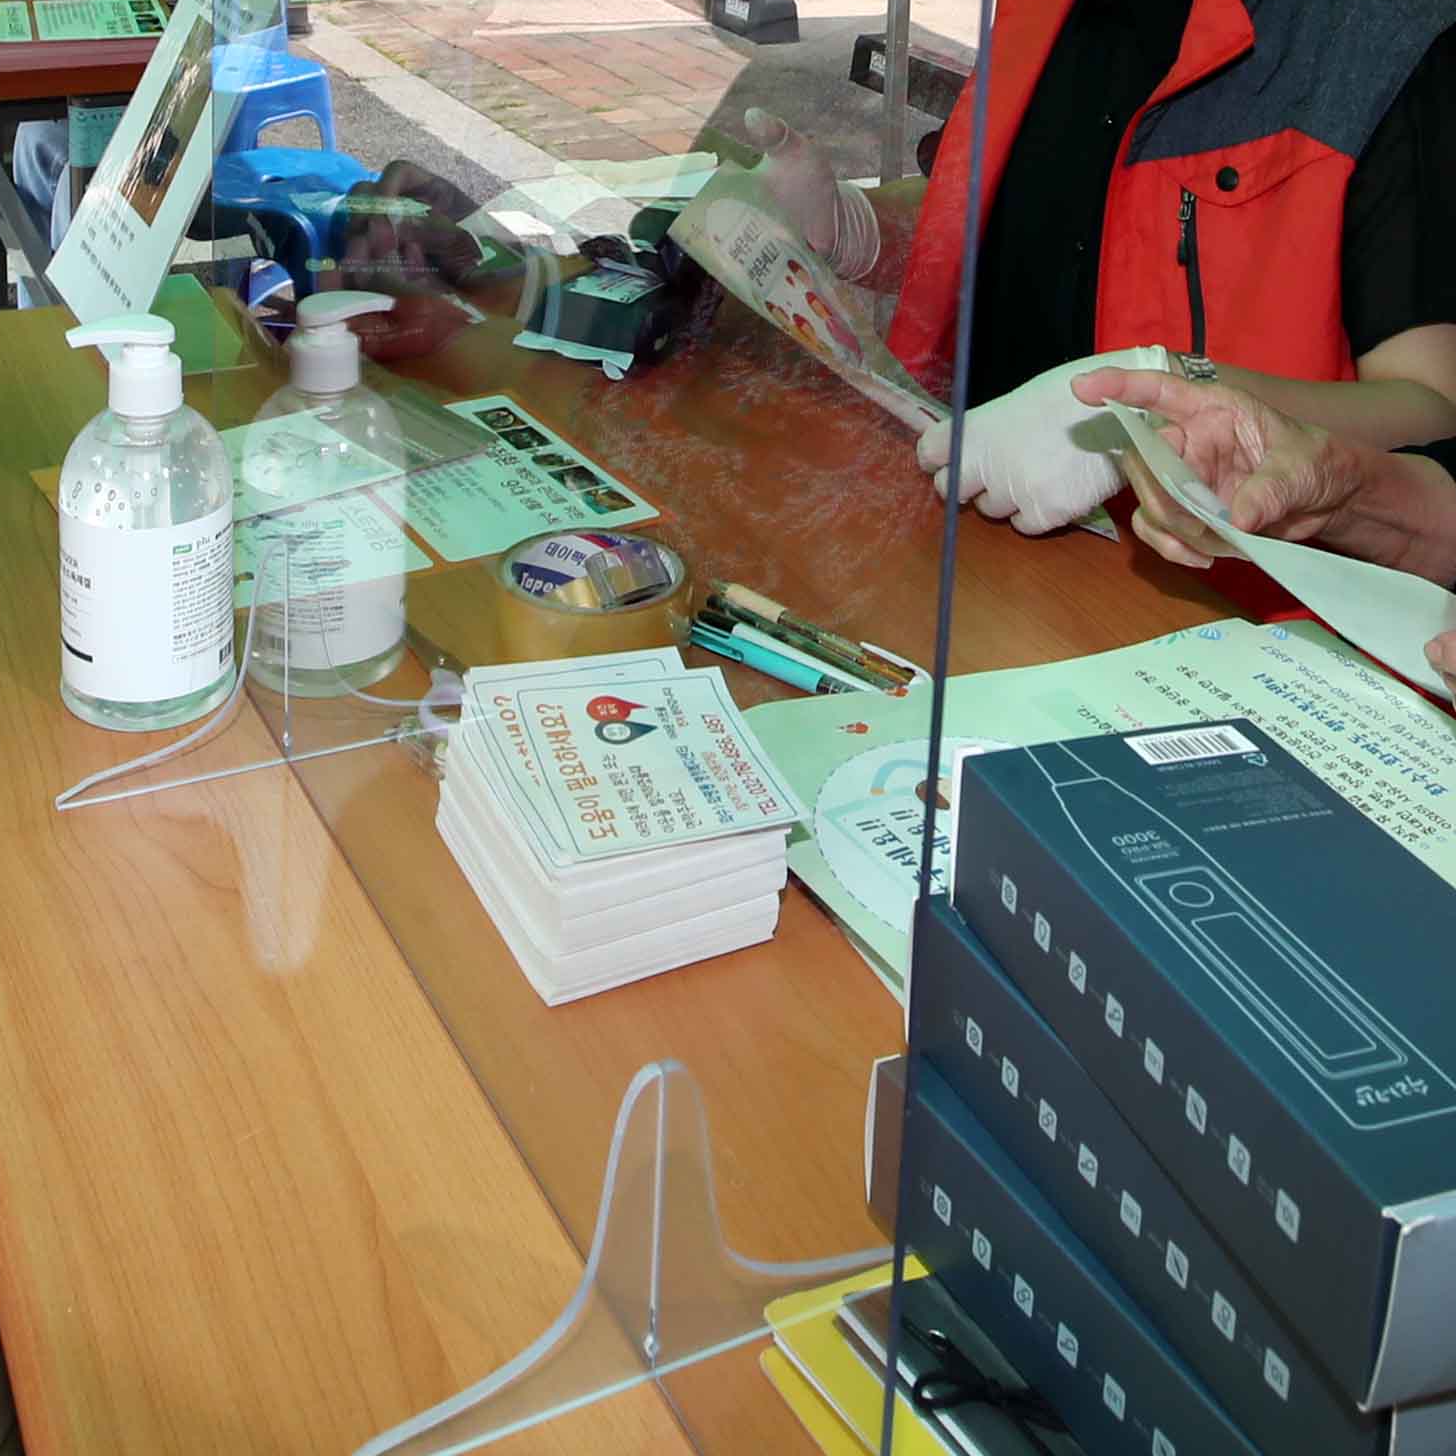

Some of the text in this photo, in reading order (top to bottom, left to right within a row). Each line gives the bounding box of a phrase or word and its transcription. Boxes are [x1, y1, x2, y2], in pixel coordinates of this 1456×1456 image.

[535, 702, 621, 841] 도움이 필요하세요?
[1111, 830, 1161, 847] 3000
